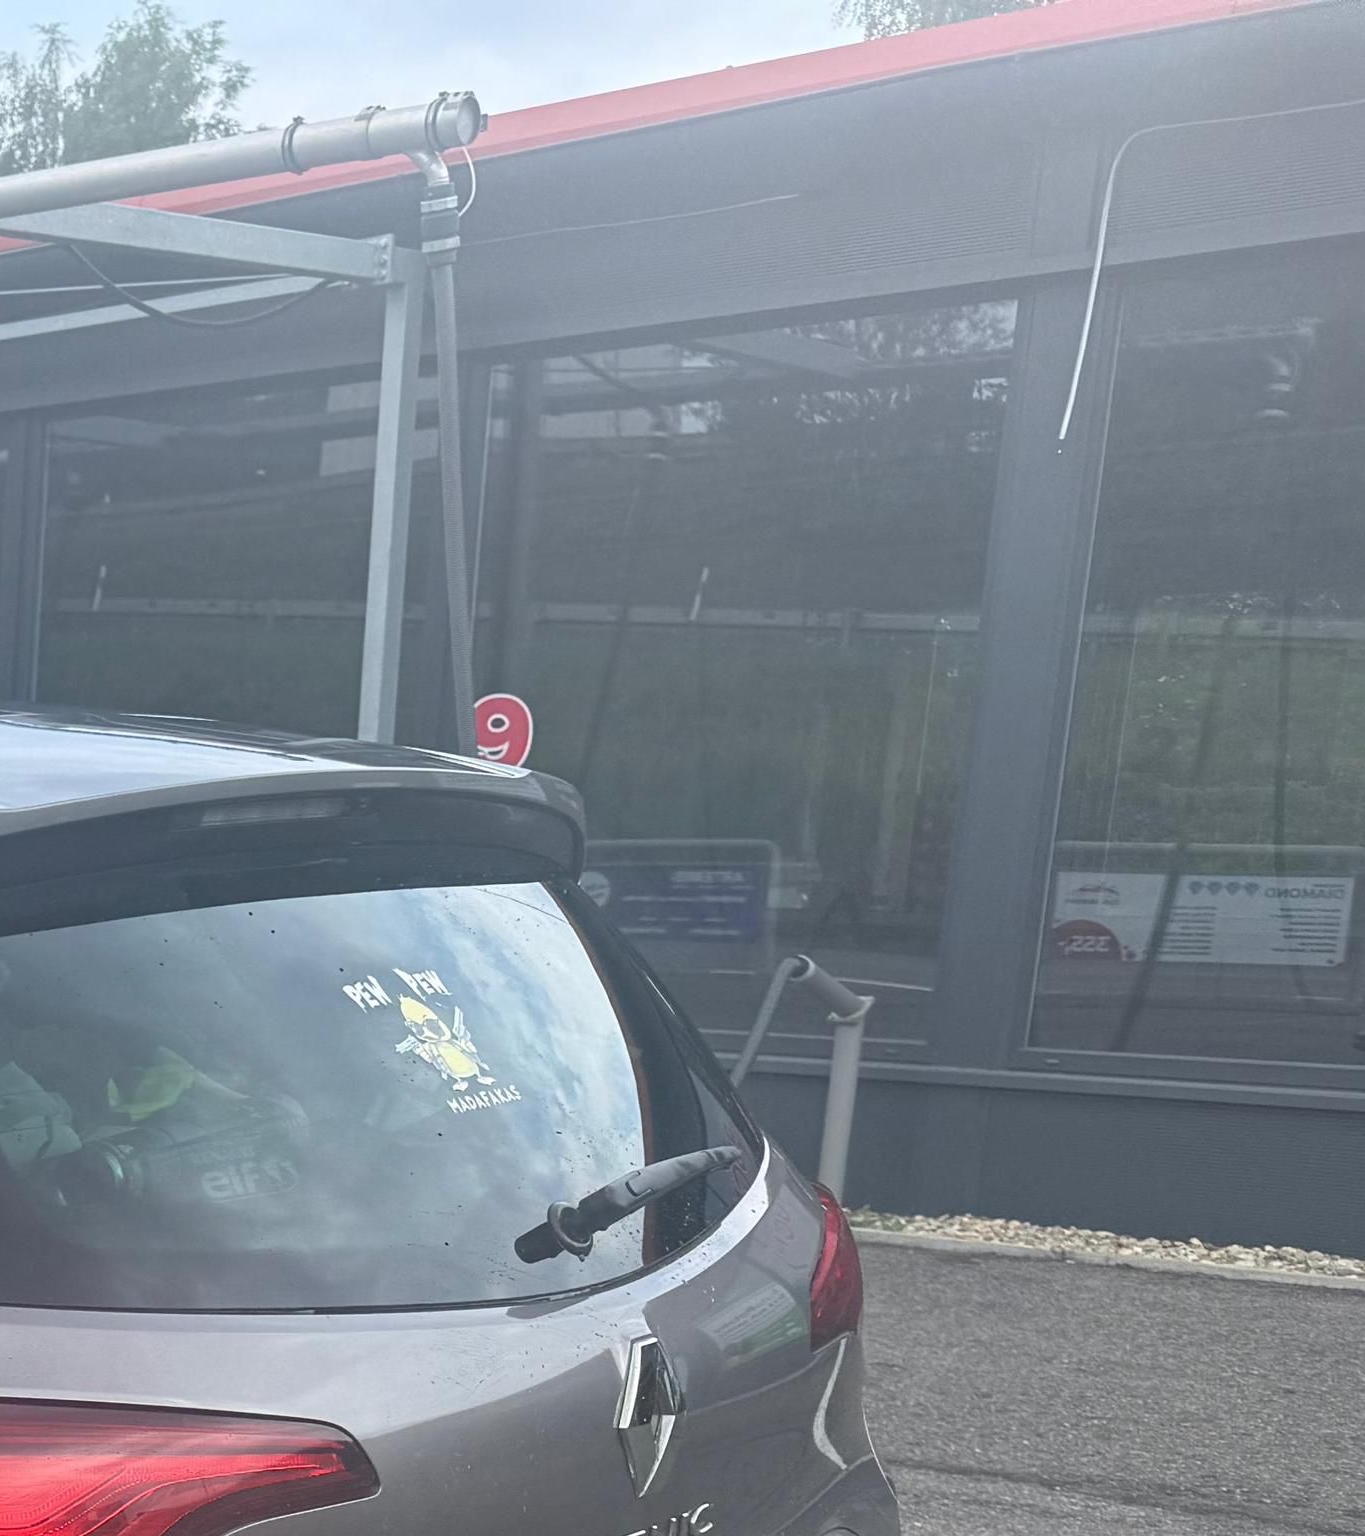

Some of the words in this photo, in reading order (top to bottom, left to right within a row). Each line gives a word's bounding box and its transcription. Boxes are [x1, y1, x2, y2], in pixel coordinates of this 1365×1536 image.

[342, 975, 392, 1014] PEW
[392, 967, 453, 1001] PEW
[446, 1085, 523, 1113] MADAFAKAS
